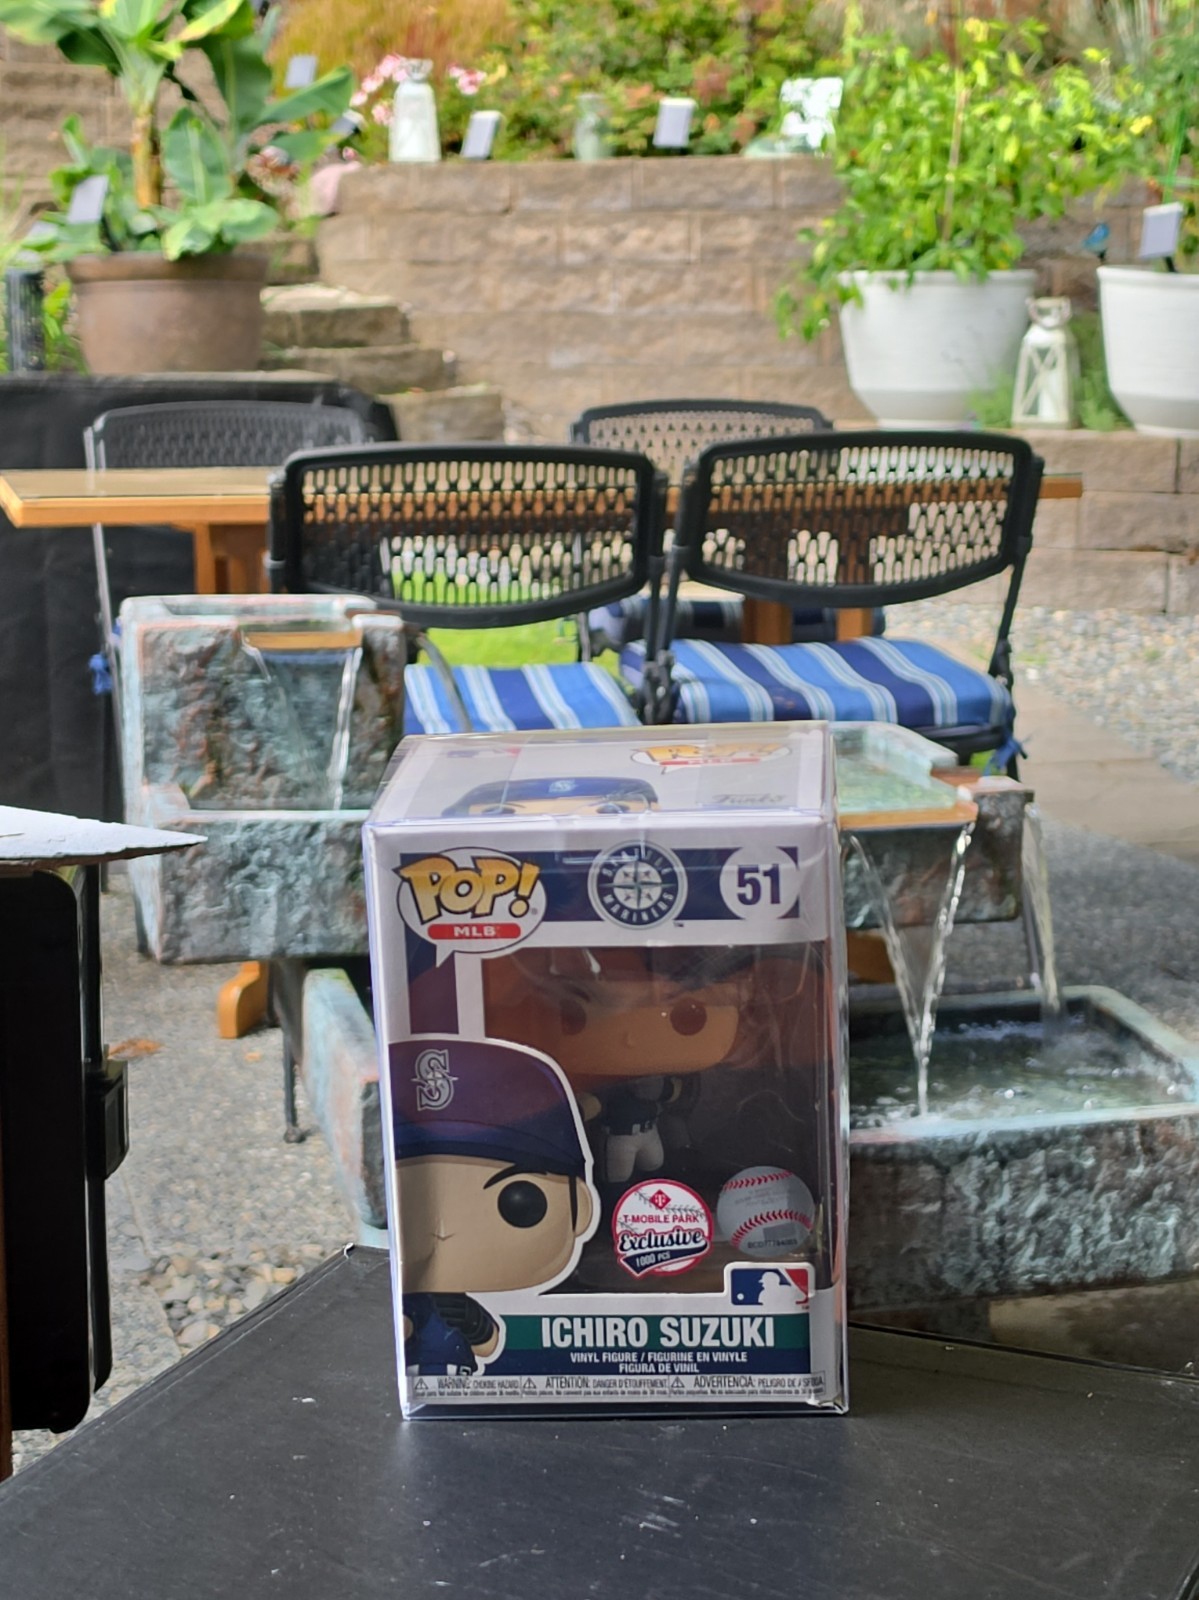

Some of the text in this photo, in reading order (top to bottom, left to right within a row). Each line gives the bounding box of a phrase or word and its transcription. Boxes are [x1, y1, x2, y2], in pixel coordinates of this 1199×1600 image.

[392, 855, 540, 925] POP!
[737, 863, 781, 906] 51
[453, 926, 496, 938] MLB
[623, 1213, 699, 1223] T-MOBILE PARK
[619, 1228, 704, 1252] Exclusive
[635, 1253, 656, 1267] 1000
[541, 1316, 775, 1348] ICHIRO SUZUKI
[570, 1352, 600, 1363] VINYL
[602, 1352, 639, 1363] FIGURE
[648, 1352, 694, 1362] FIGURINE
[697, 1352, 710, 1362] EN
[712, 1351, 748, 1362] VINYLE
[619, 1363, 700, 1373] FIGURA DE VINIL
